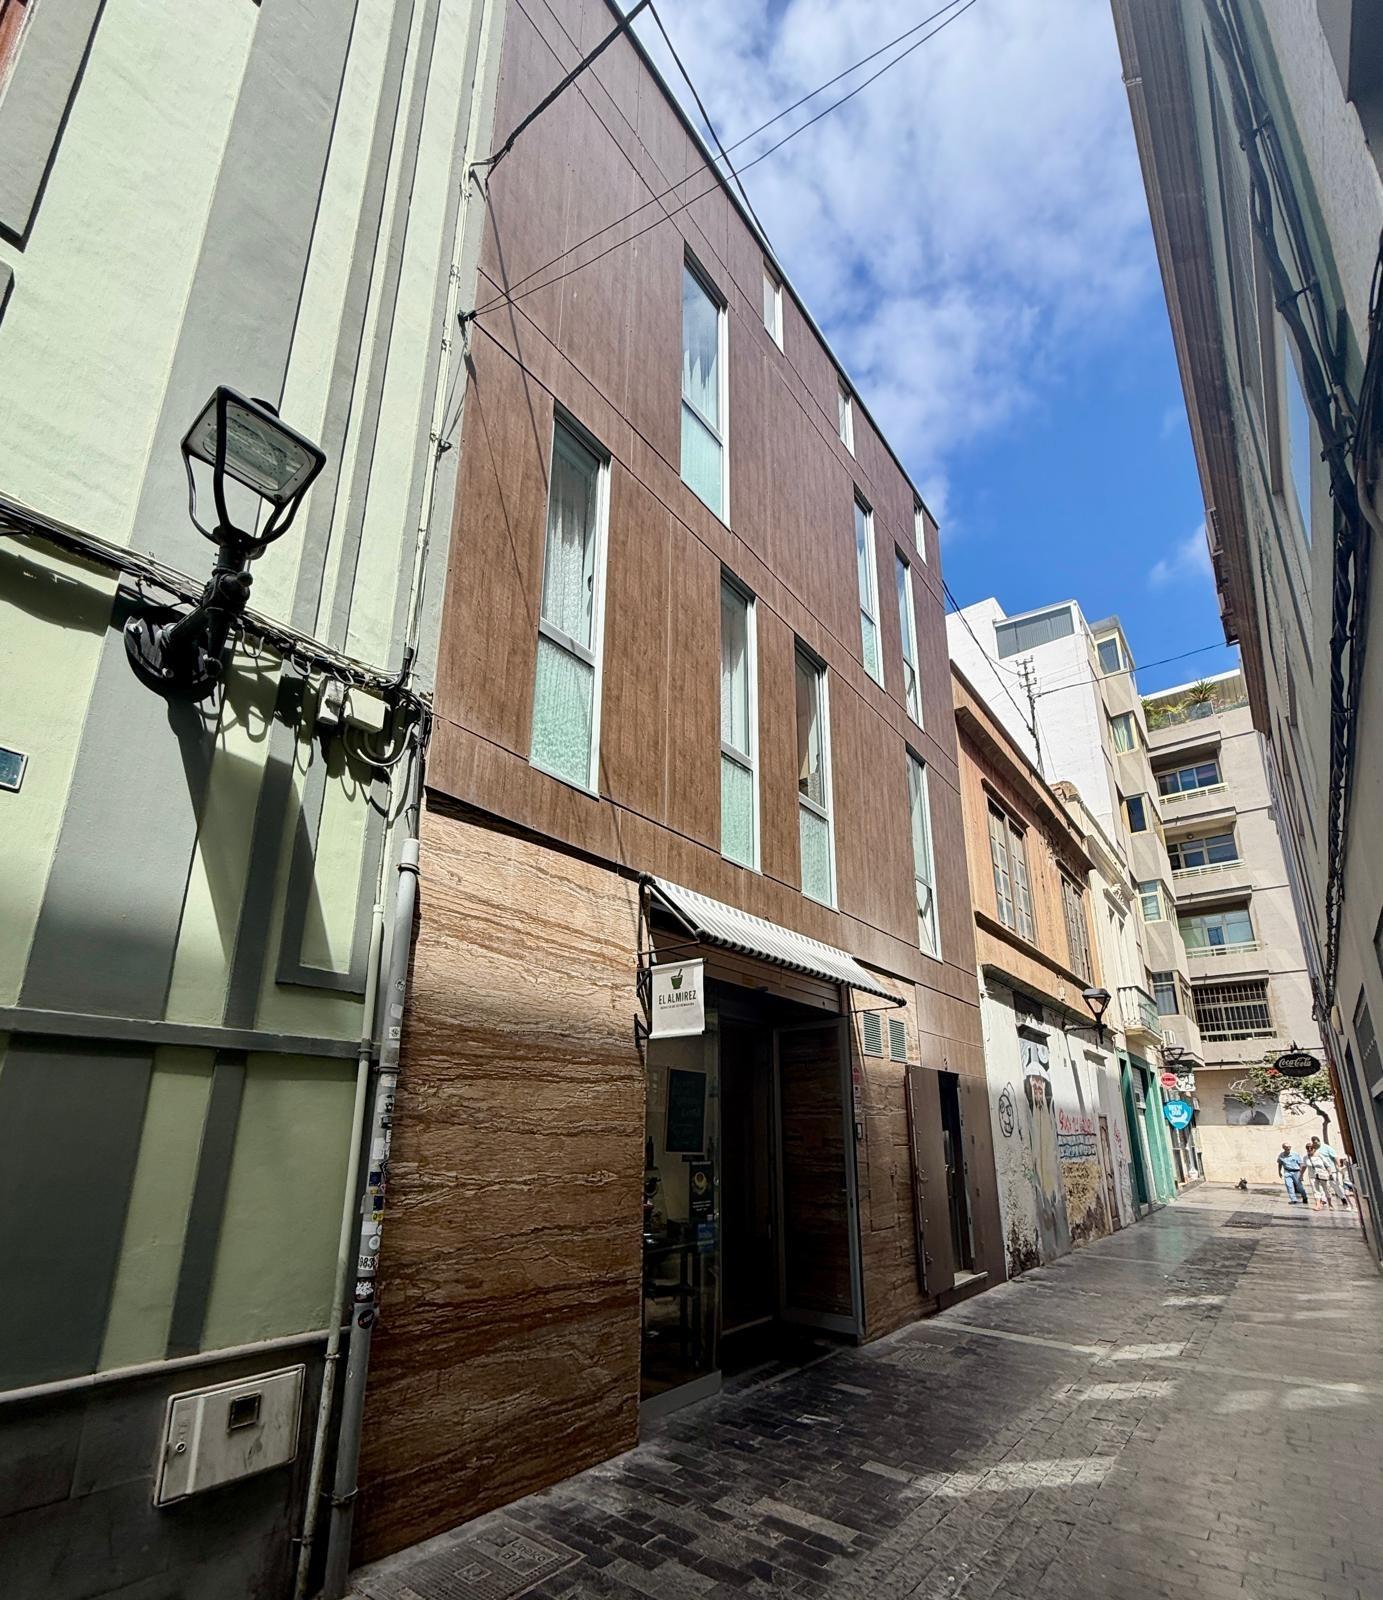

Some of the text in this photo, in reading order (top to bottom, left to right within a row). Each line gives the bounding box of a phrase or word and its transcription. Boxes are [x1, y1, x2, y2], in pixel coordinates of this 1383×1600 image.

[658, 989, 697, 1005] EL ALMIREZ
[501, 1550, 525, 1562] BT
